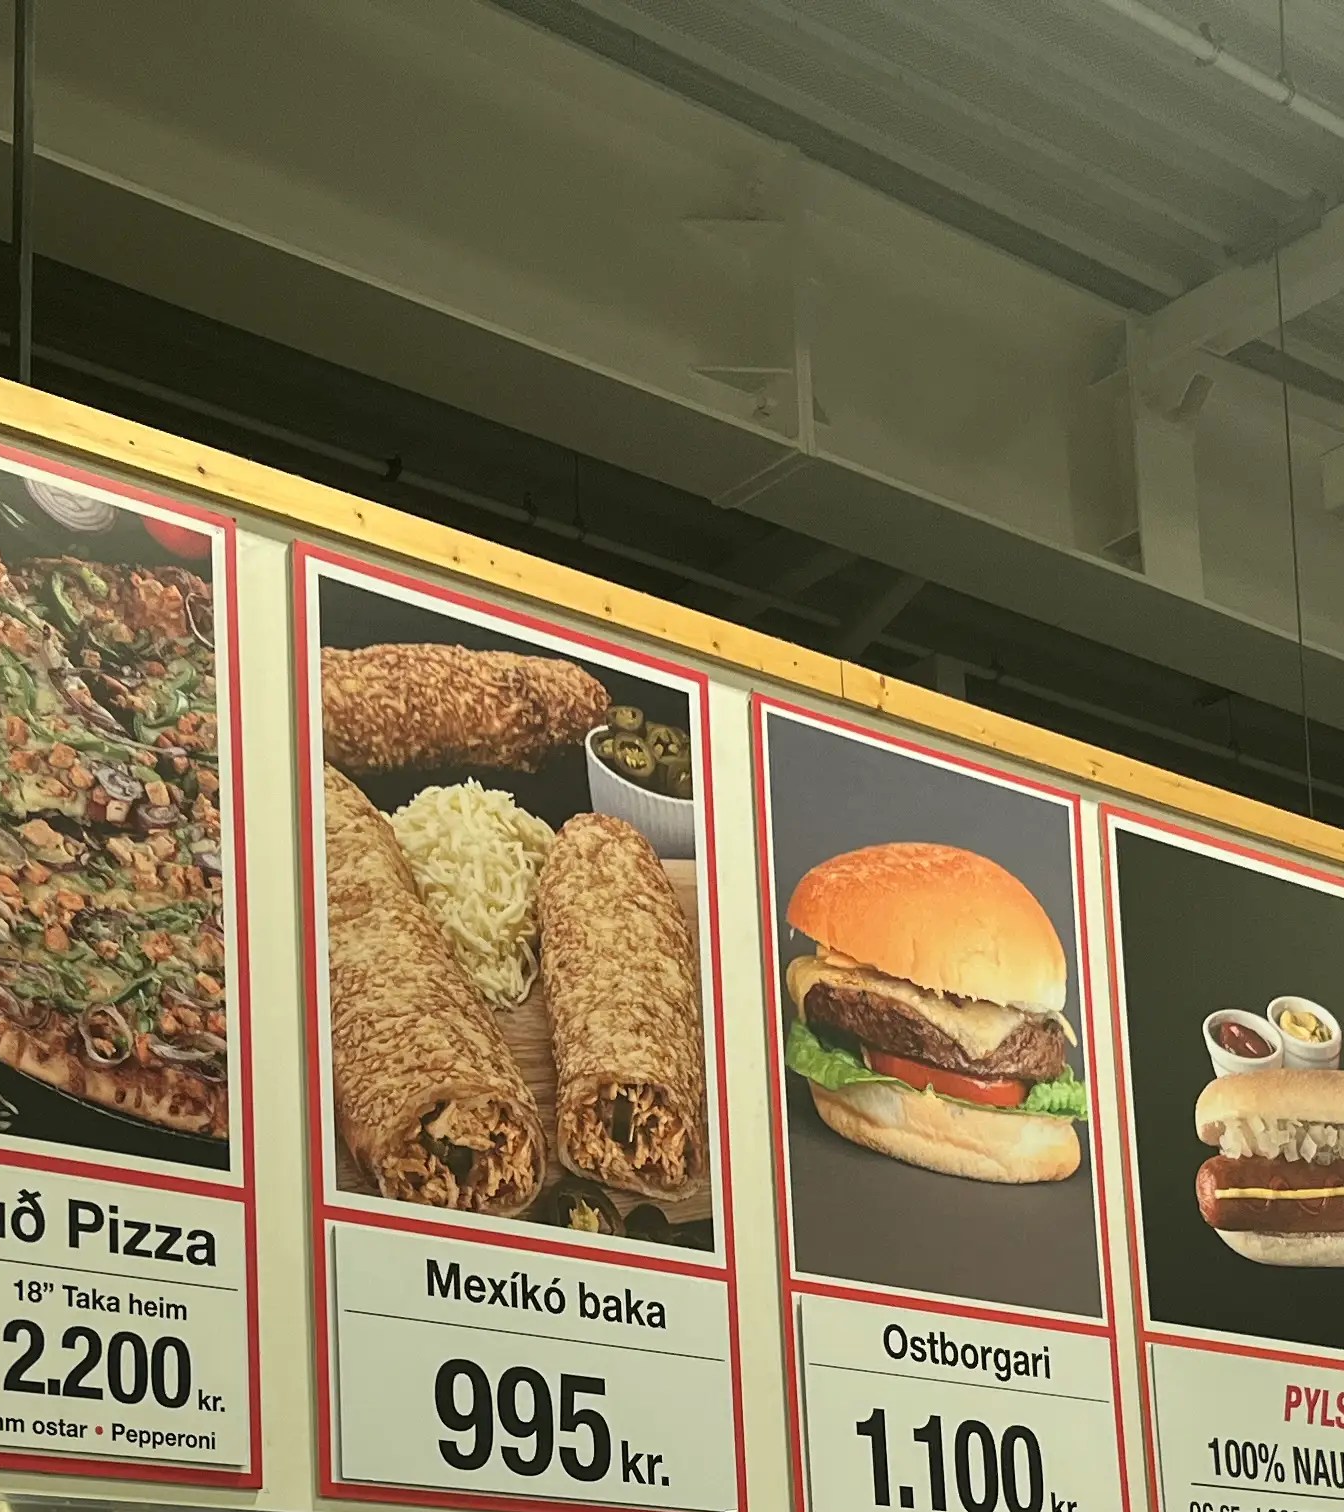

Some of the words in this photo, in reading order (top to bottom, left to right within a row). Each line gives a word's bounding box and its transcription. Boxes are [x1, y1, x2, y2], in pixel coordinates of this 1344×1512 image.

[68, 1198, 216, 1267] Pizza
[62, 1285, 120, 1313] Taka
[129, 1293, 187, 1321] heim
[426, 1259, 566, 1314] Mexíkó
[578, 1281, 666, 1329] baka
[883, 1324, 1050, 1382] Ostborgari
[32, 1419, 88, 1438] ostar
[112, 1423, 215, 1450] Pepperoni
[1208, 1437, 1285, 1483] 100%
